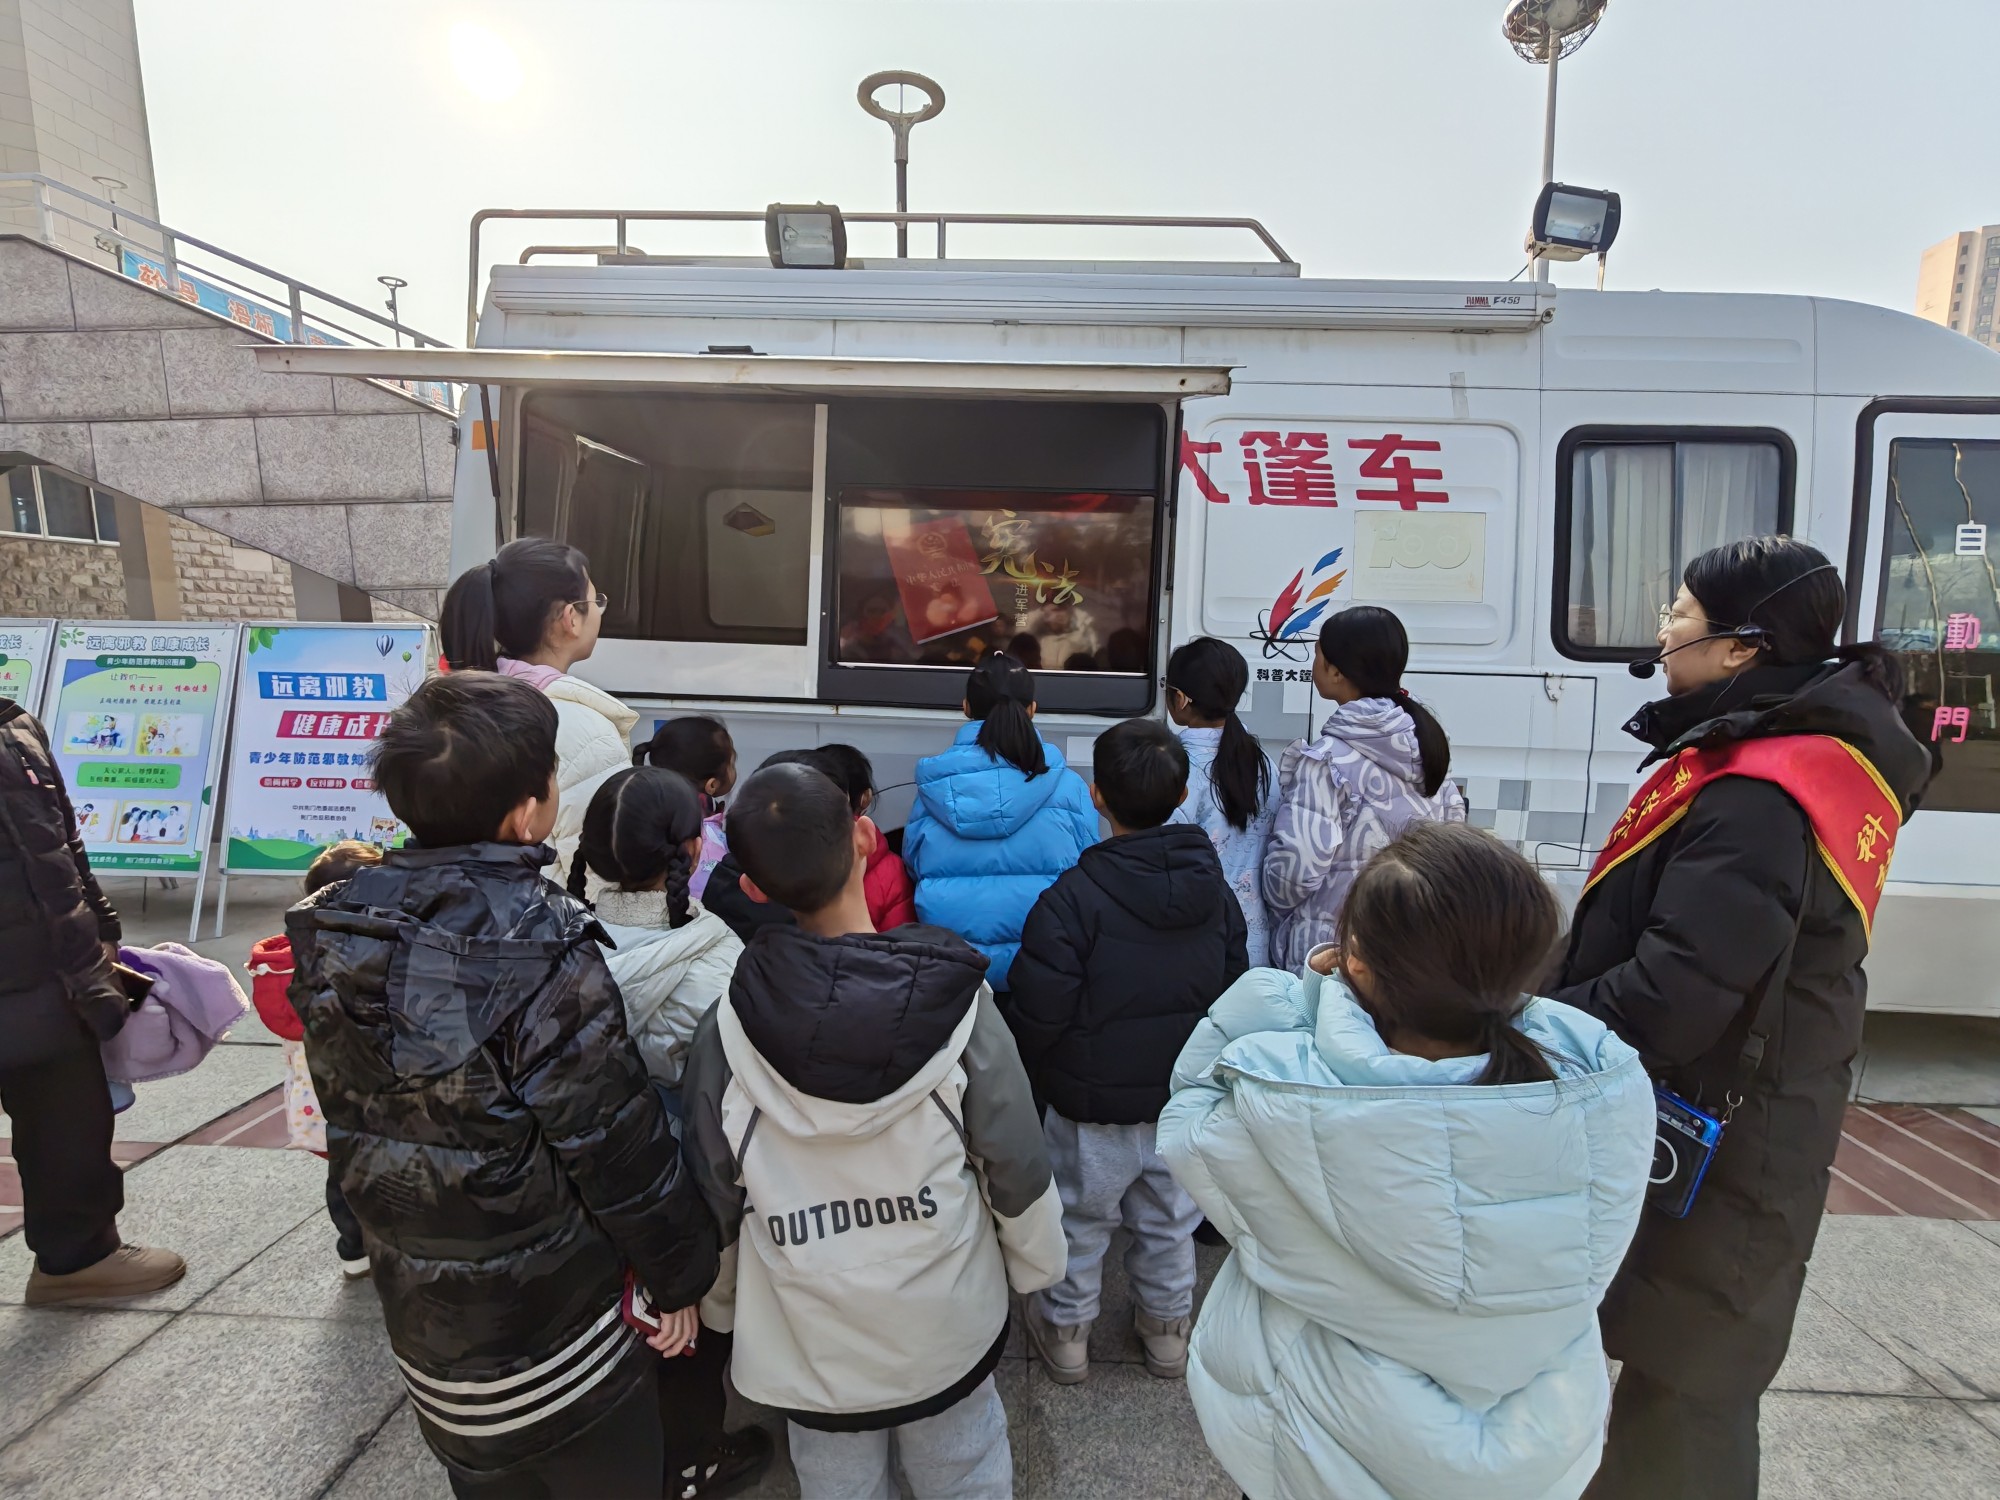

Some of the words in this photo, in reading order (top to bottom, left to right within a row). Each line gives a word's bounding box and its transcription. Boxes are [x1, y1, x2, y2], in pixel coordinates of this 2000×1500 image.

[1466, 296, 1489, 306] FIAMMA
[86, 635, 147, 651] 远离邪教
[151, 637, 210, 652] 健康成长
[271, 674, 375, 698] 远离邪教
[768, 1186, 938, 1246] OUTDOORS
